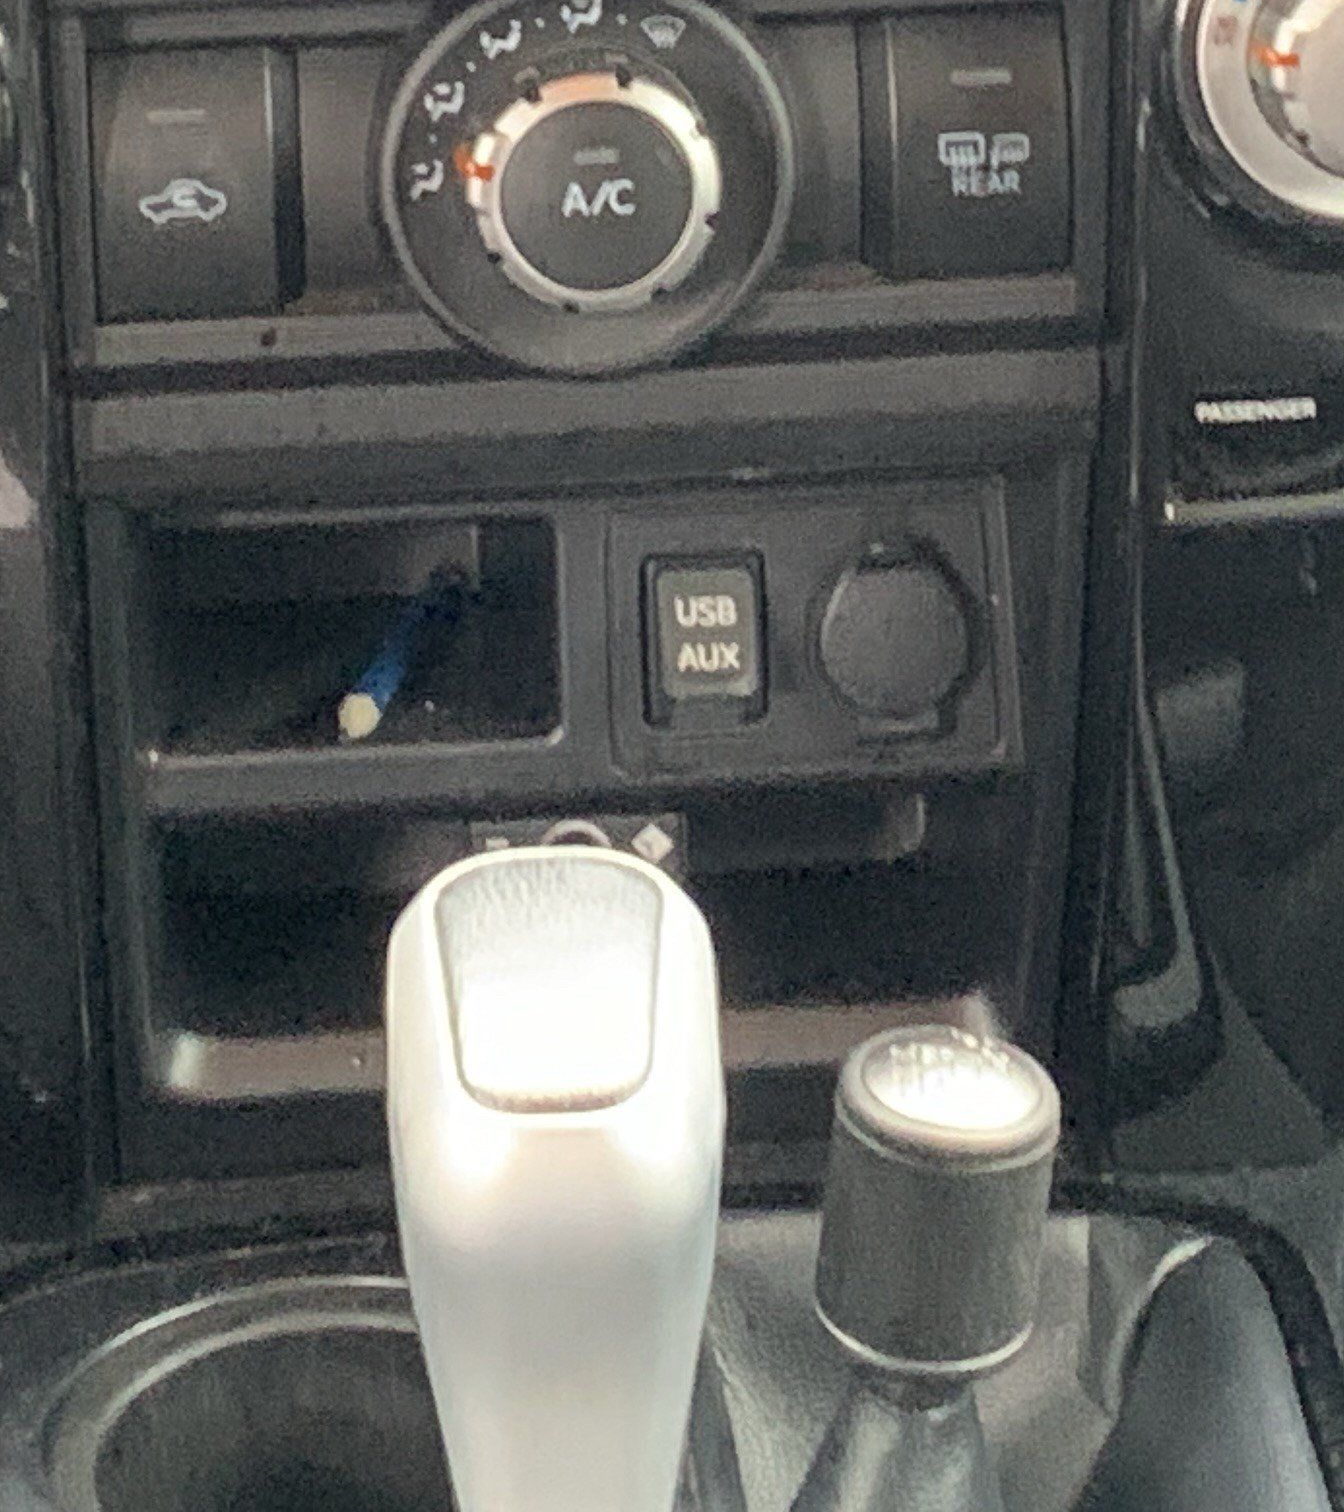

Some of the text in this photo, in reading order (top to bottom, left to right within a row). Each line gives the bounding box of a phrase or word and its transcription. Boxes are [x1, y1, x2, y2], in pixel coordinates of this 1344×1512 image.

[951, 166, 1021, 196] REAR
[561, 178, 637, 219] A/C
[674, 594, 739, 628] USB
[676, 640, 741, 672] AUX
